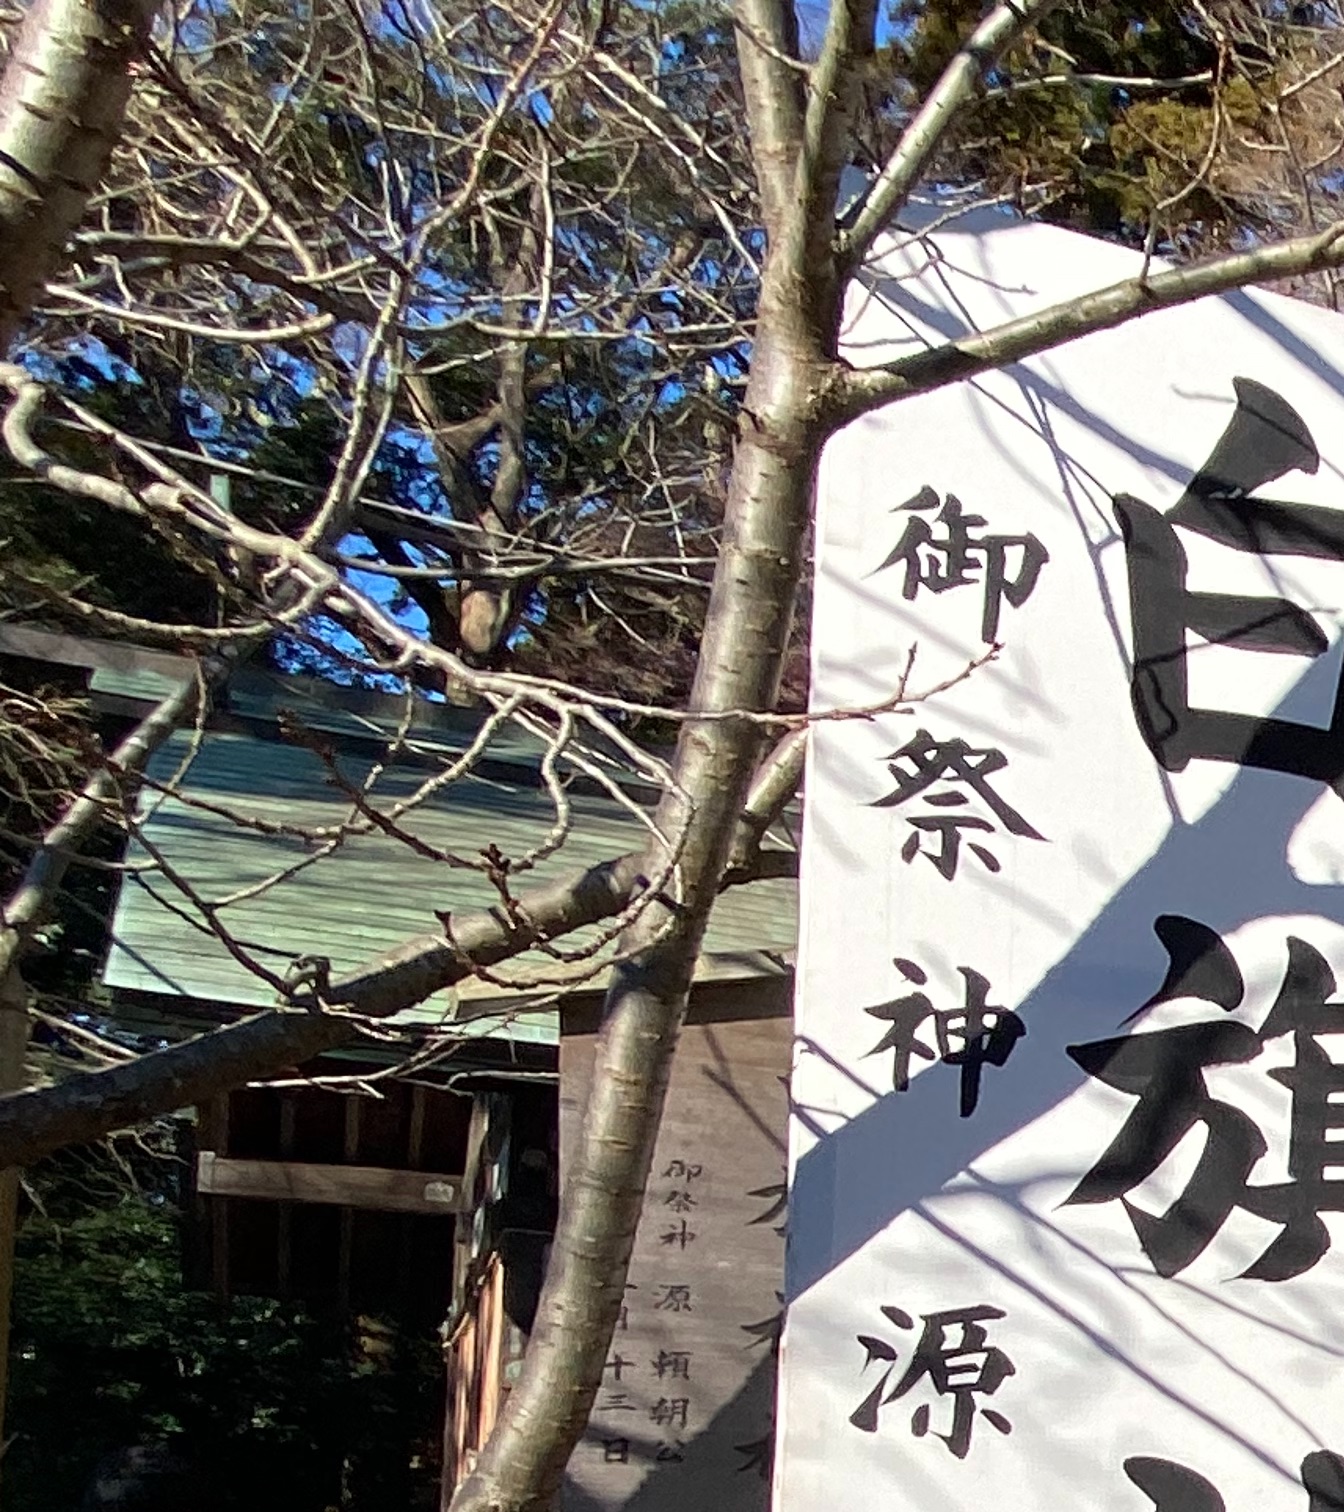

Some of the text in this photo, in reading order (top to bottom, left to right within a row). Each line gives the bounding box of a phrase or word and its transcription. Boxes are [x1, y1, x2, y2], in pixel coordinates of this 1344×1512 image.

[864, 486, 1049, 1118] 御祭神
[660, 1159, 702, 1250] 御祭神
